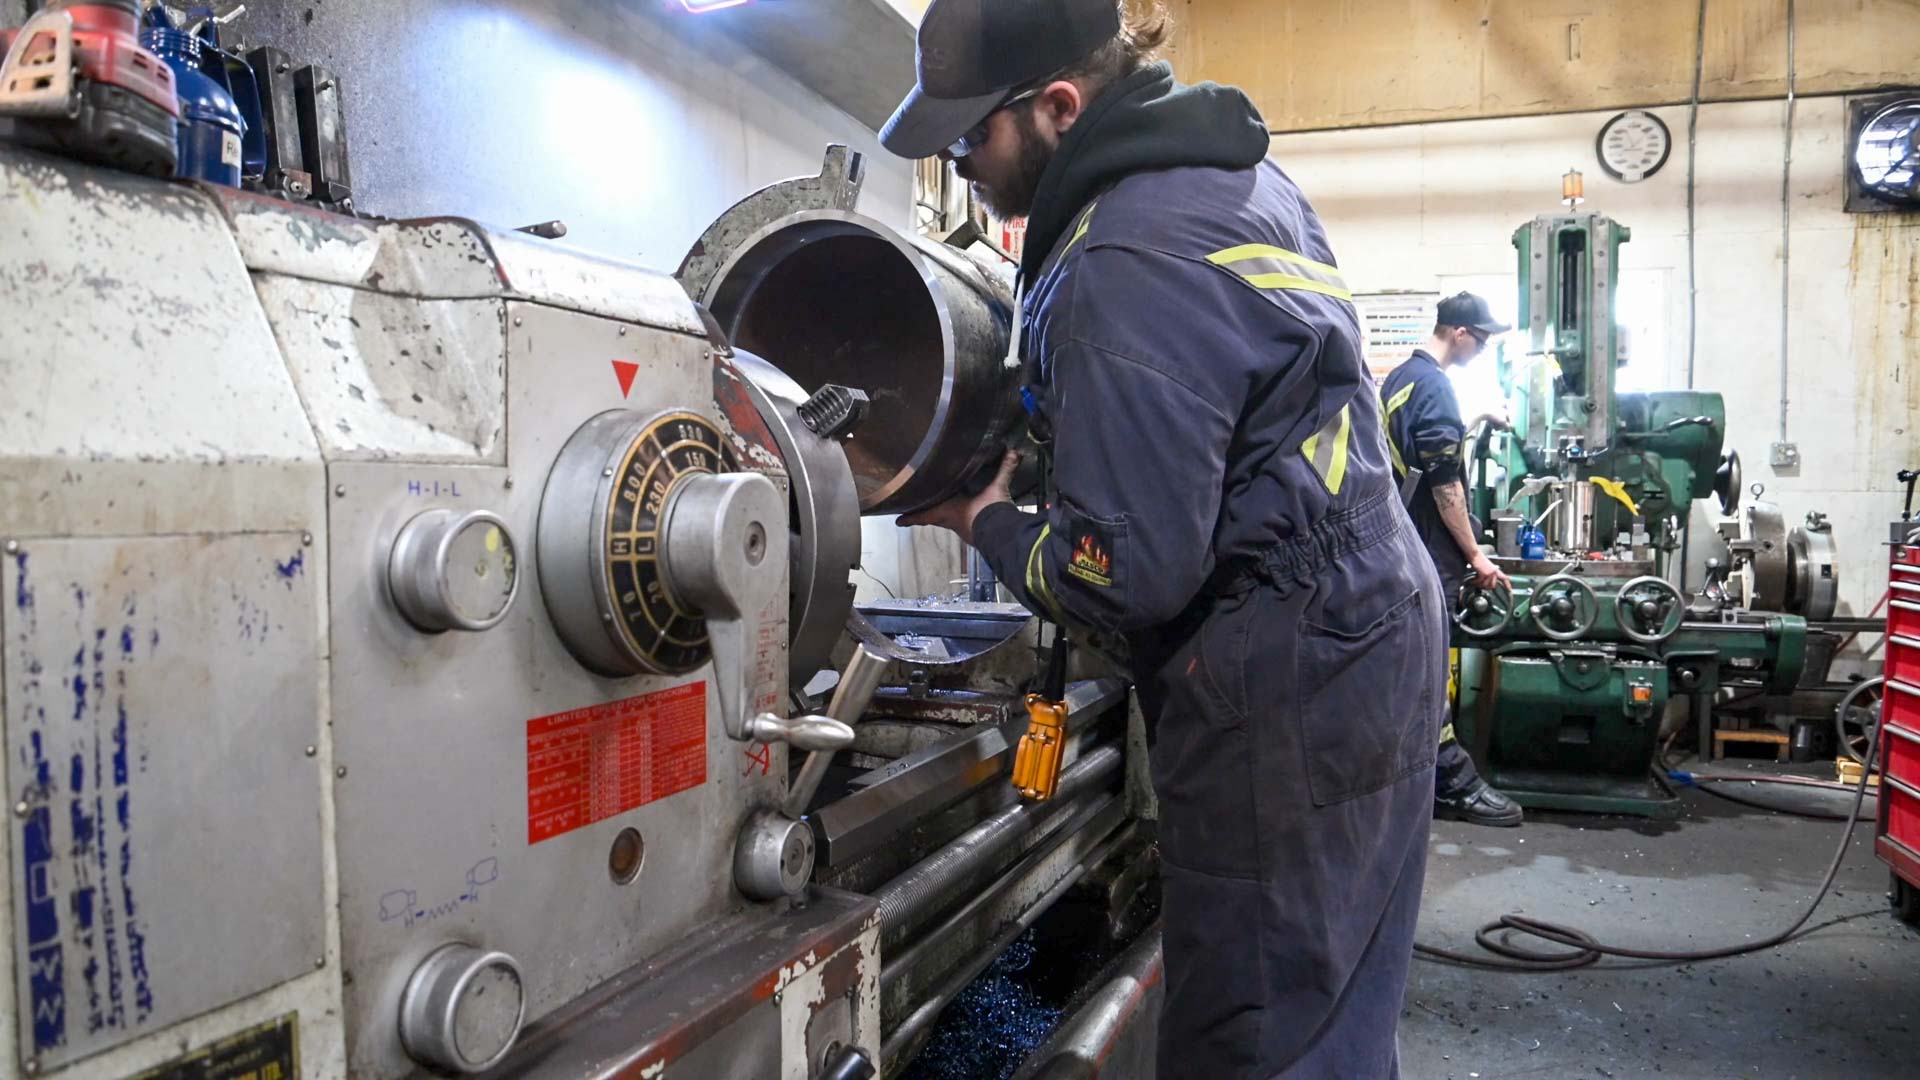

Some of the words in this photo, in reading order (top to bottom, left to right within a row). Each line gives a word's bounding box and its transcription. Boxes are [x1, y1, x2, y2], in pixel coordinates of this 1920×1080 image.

[678, 424, 703, 442] 530
[685, 451, 706, 468] 150
[623, 461, 646, 502] 800
[646, 480, 666, 515] 230
[613, 541, 628, 553] H
[638, 541, 652, 552] L
[548, 710, 589, 725] LIMITED
